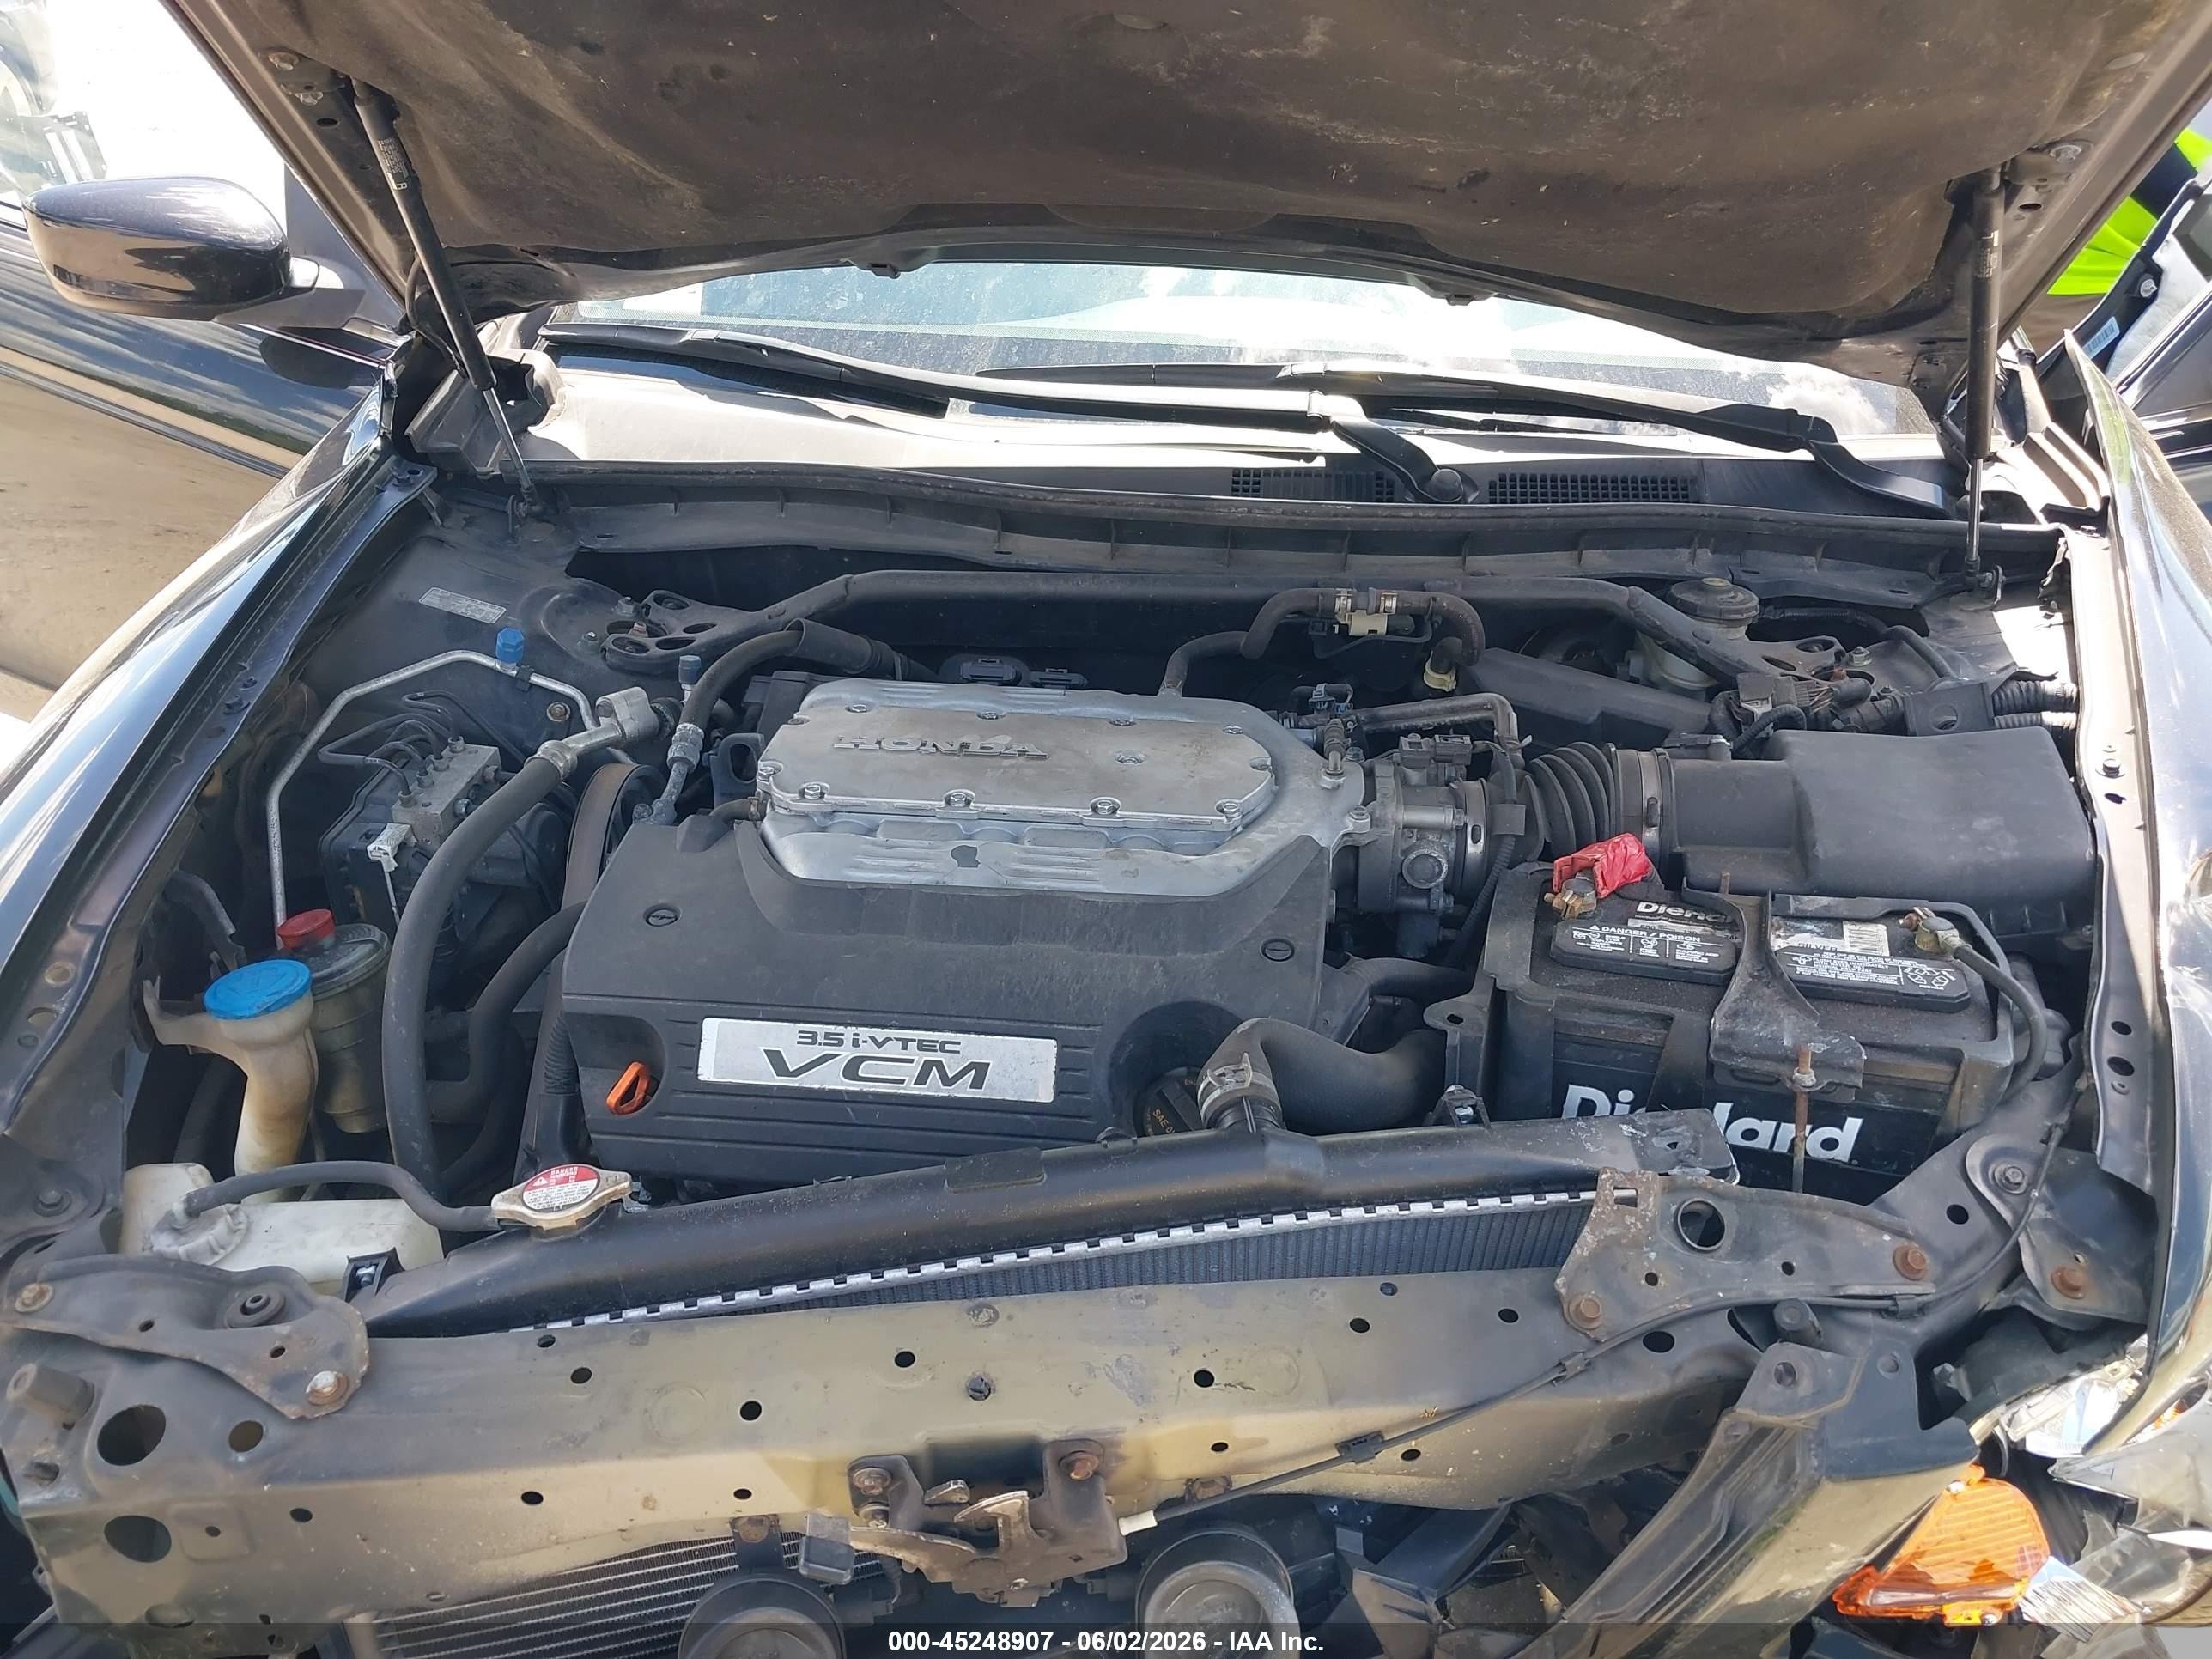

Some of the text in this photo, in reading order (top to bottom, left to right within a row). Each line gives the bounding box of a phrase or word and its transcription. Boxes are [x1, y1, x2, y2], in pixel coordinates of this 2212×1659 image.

[833, 735, 1050, 759] HONDA
[1601, 926, 1648, 937] DANGER
[1659, 932, 1701, 942] POISON
[797, 1030, 844, 1047] 3.5
[763, 1048, 992, 1090] VCM
[1153, 1109, 1169, 1127] SAE
